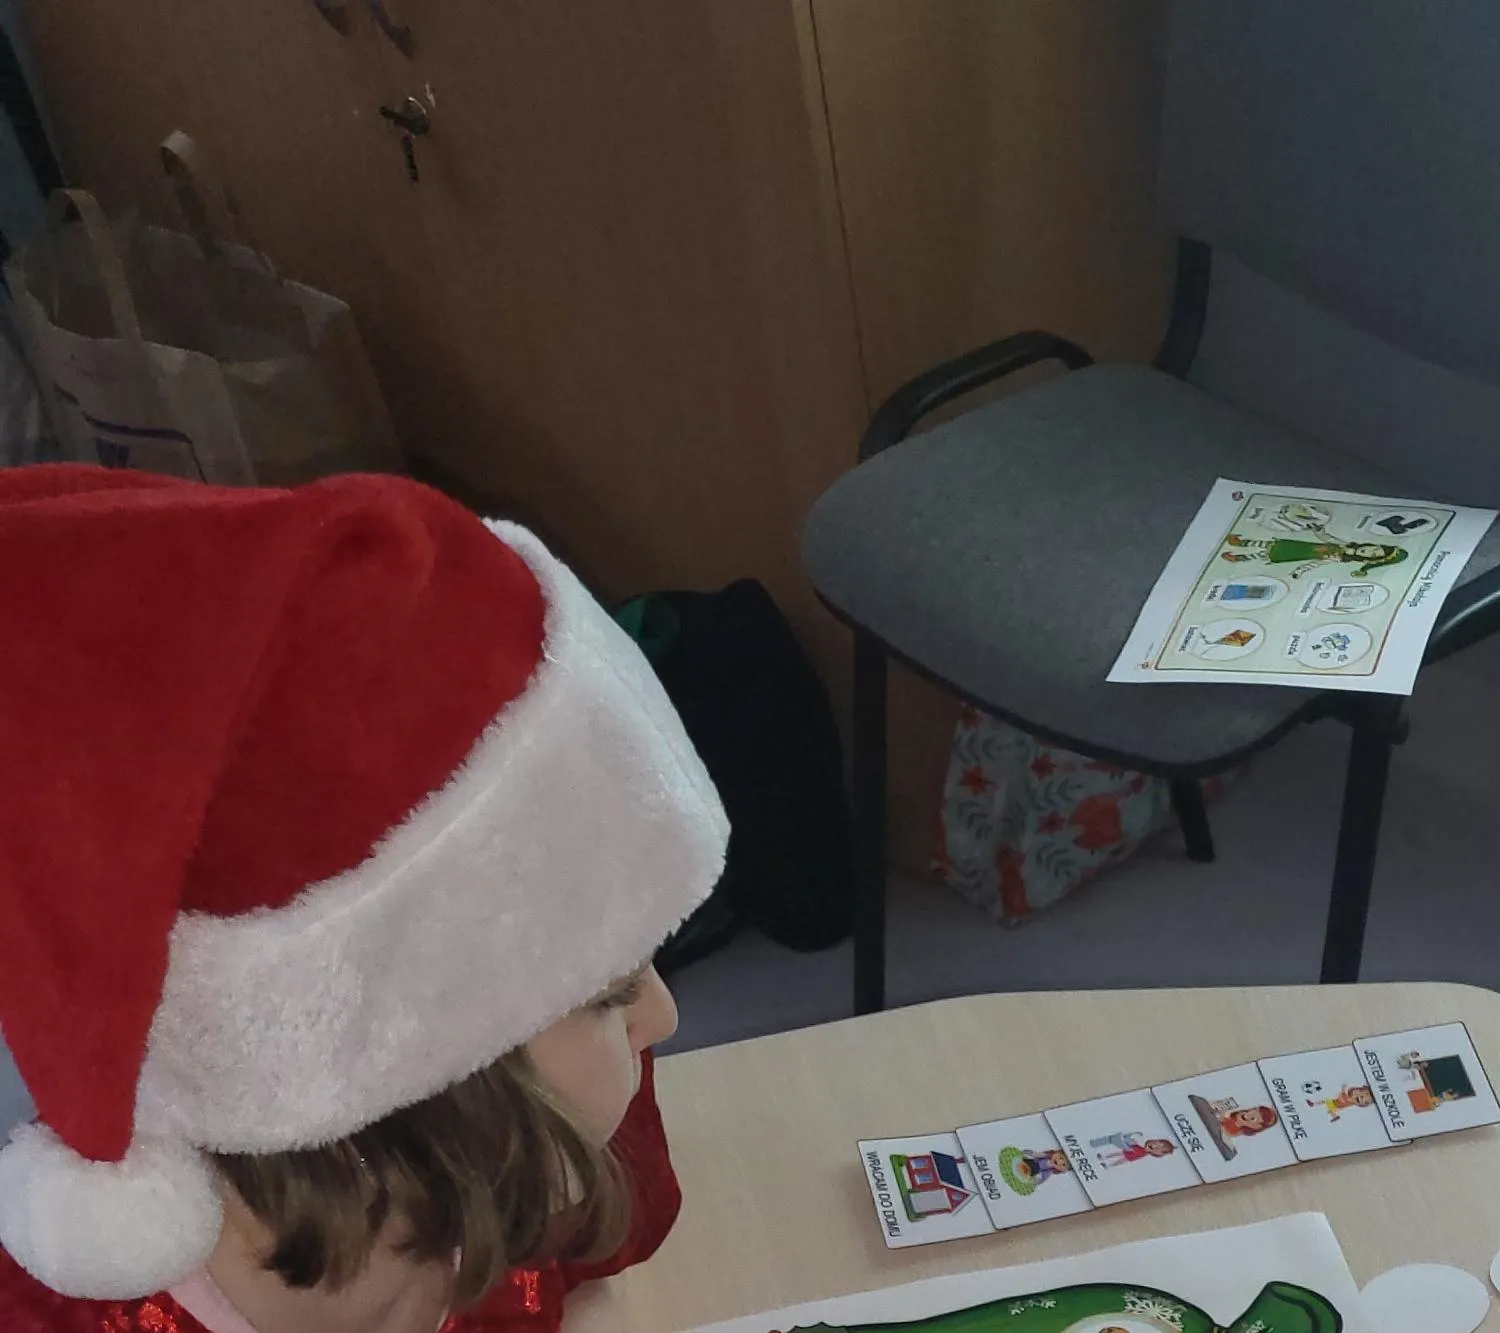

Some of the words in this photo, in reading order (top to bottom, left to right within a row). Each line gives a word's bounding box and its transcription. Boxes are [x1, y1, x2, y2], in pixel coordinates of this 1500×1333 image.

[1364, 1050, 1387, 1082] JESTEM
[1272, 1078, 1290, 1104] GRAM
[1377, 1082, 1389, 1092] W
[1382, 1092, 1404, 1129] SZKOLE
[866, 1151, 888, 1194] WRACAM
[972, 1154, 987, 1172] JEM
[981, 1171, 1001, 1200] OBIAD
[878, 1193, 892, 1207] DO
[882, 1206, 901, 1237] DOMU
